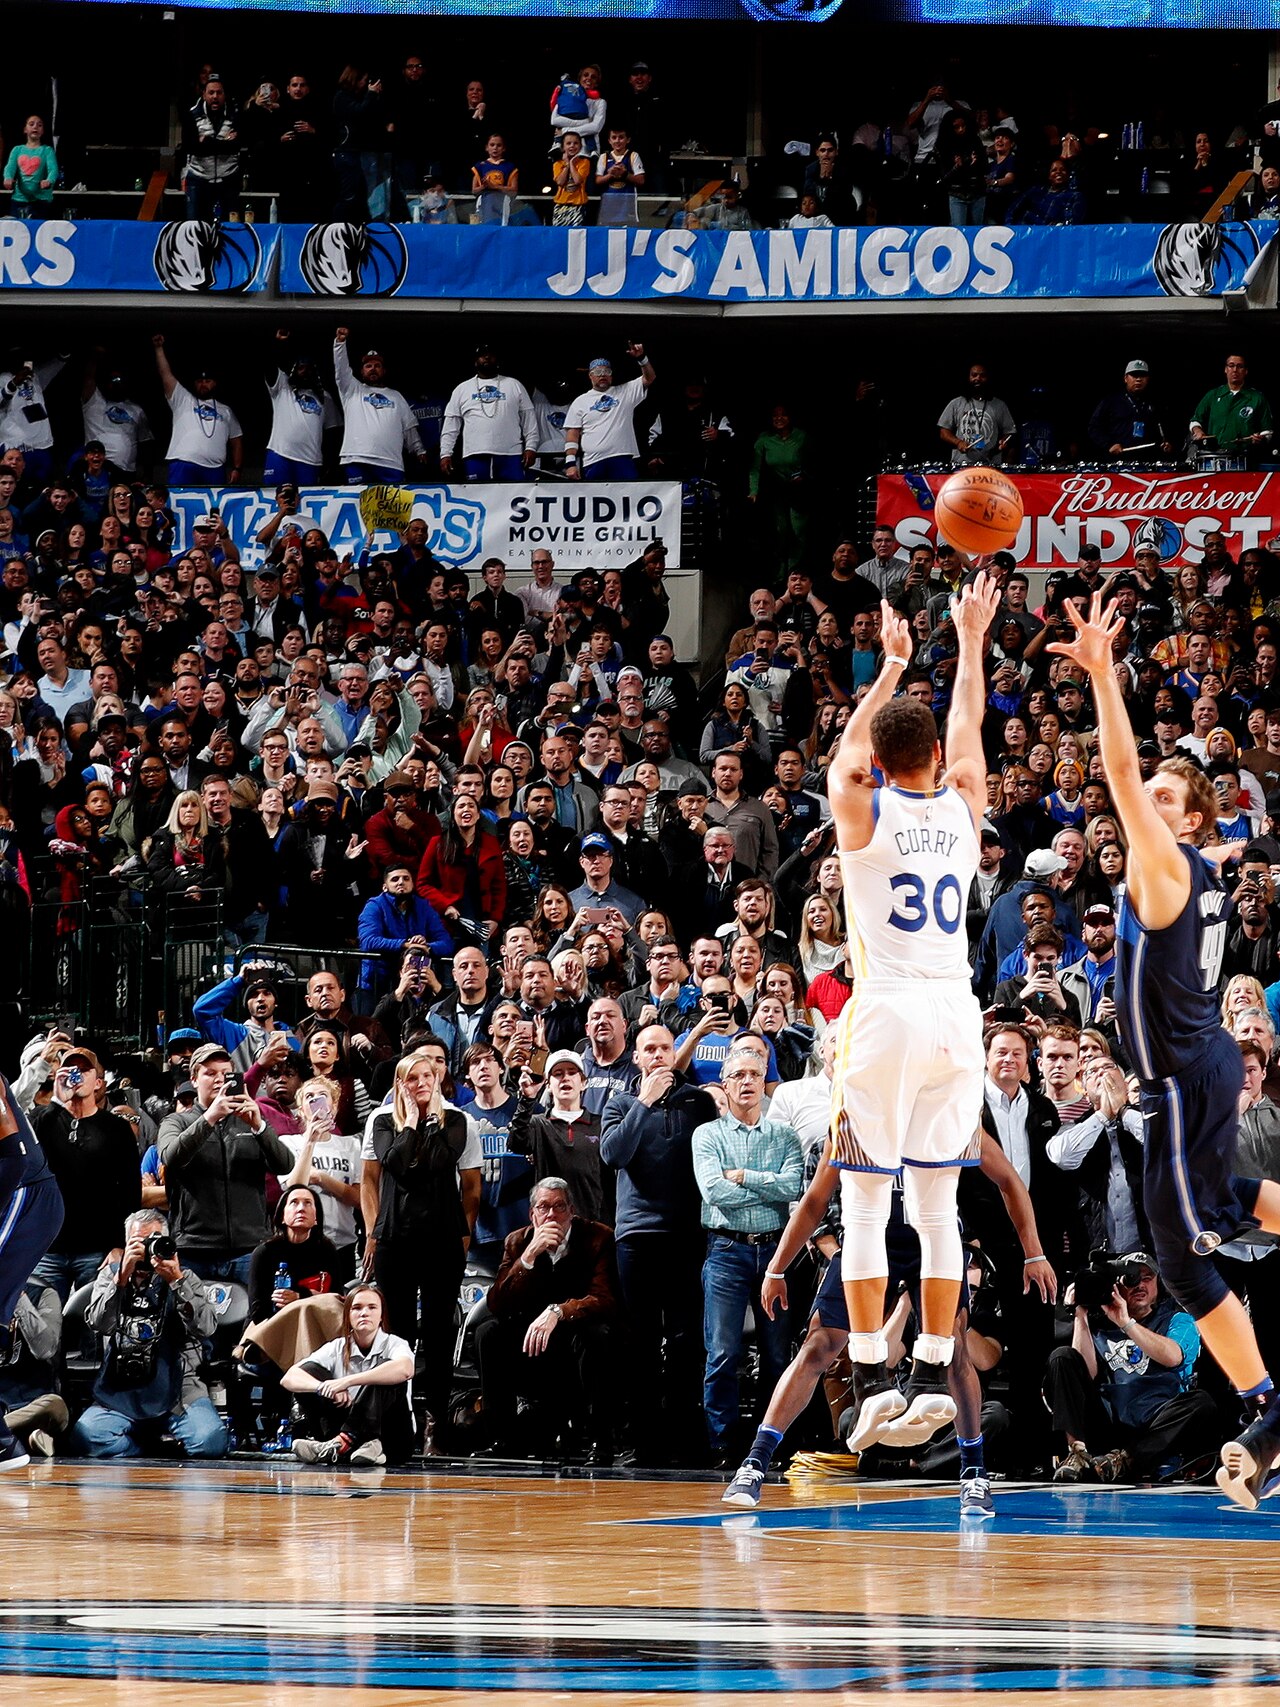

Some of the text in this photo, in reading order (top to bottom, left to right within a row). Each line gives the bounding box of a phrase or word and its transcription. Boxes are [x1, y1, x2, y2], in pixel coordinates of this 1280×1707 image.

[547, 226, 1015, 297] JJ'S AMIGOS
[963, 474, 1020, 502] SPALDING
[1060, 472, 1256, 513] Budweiser
[509, 495, 663, 524] STUDIO
[508, 526, 663, 542] MOVIE GRILL
[894, 515, 1134, 564] SUND
[550, 549, 593, 557] RINK
[604, 548, 642, 556] MOVI
[894, 828, 959, 858] CURRY
[887, 872, 962, 935] 30
[696, 1044, 728, 1062] DALL
[312, 1155, 351, 1173] ALLAS
